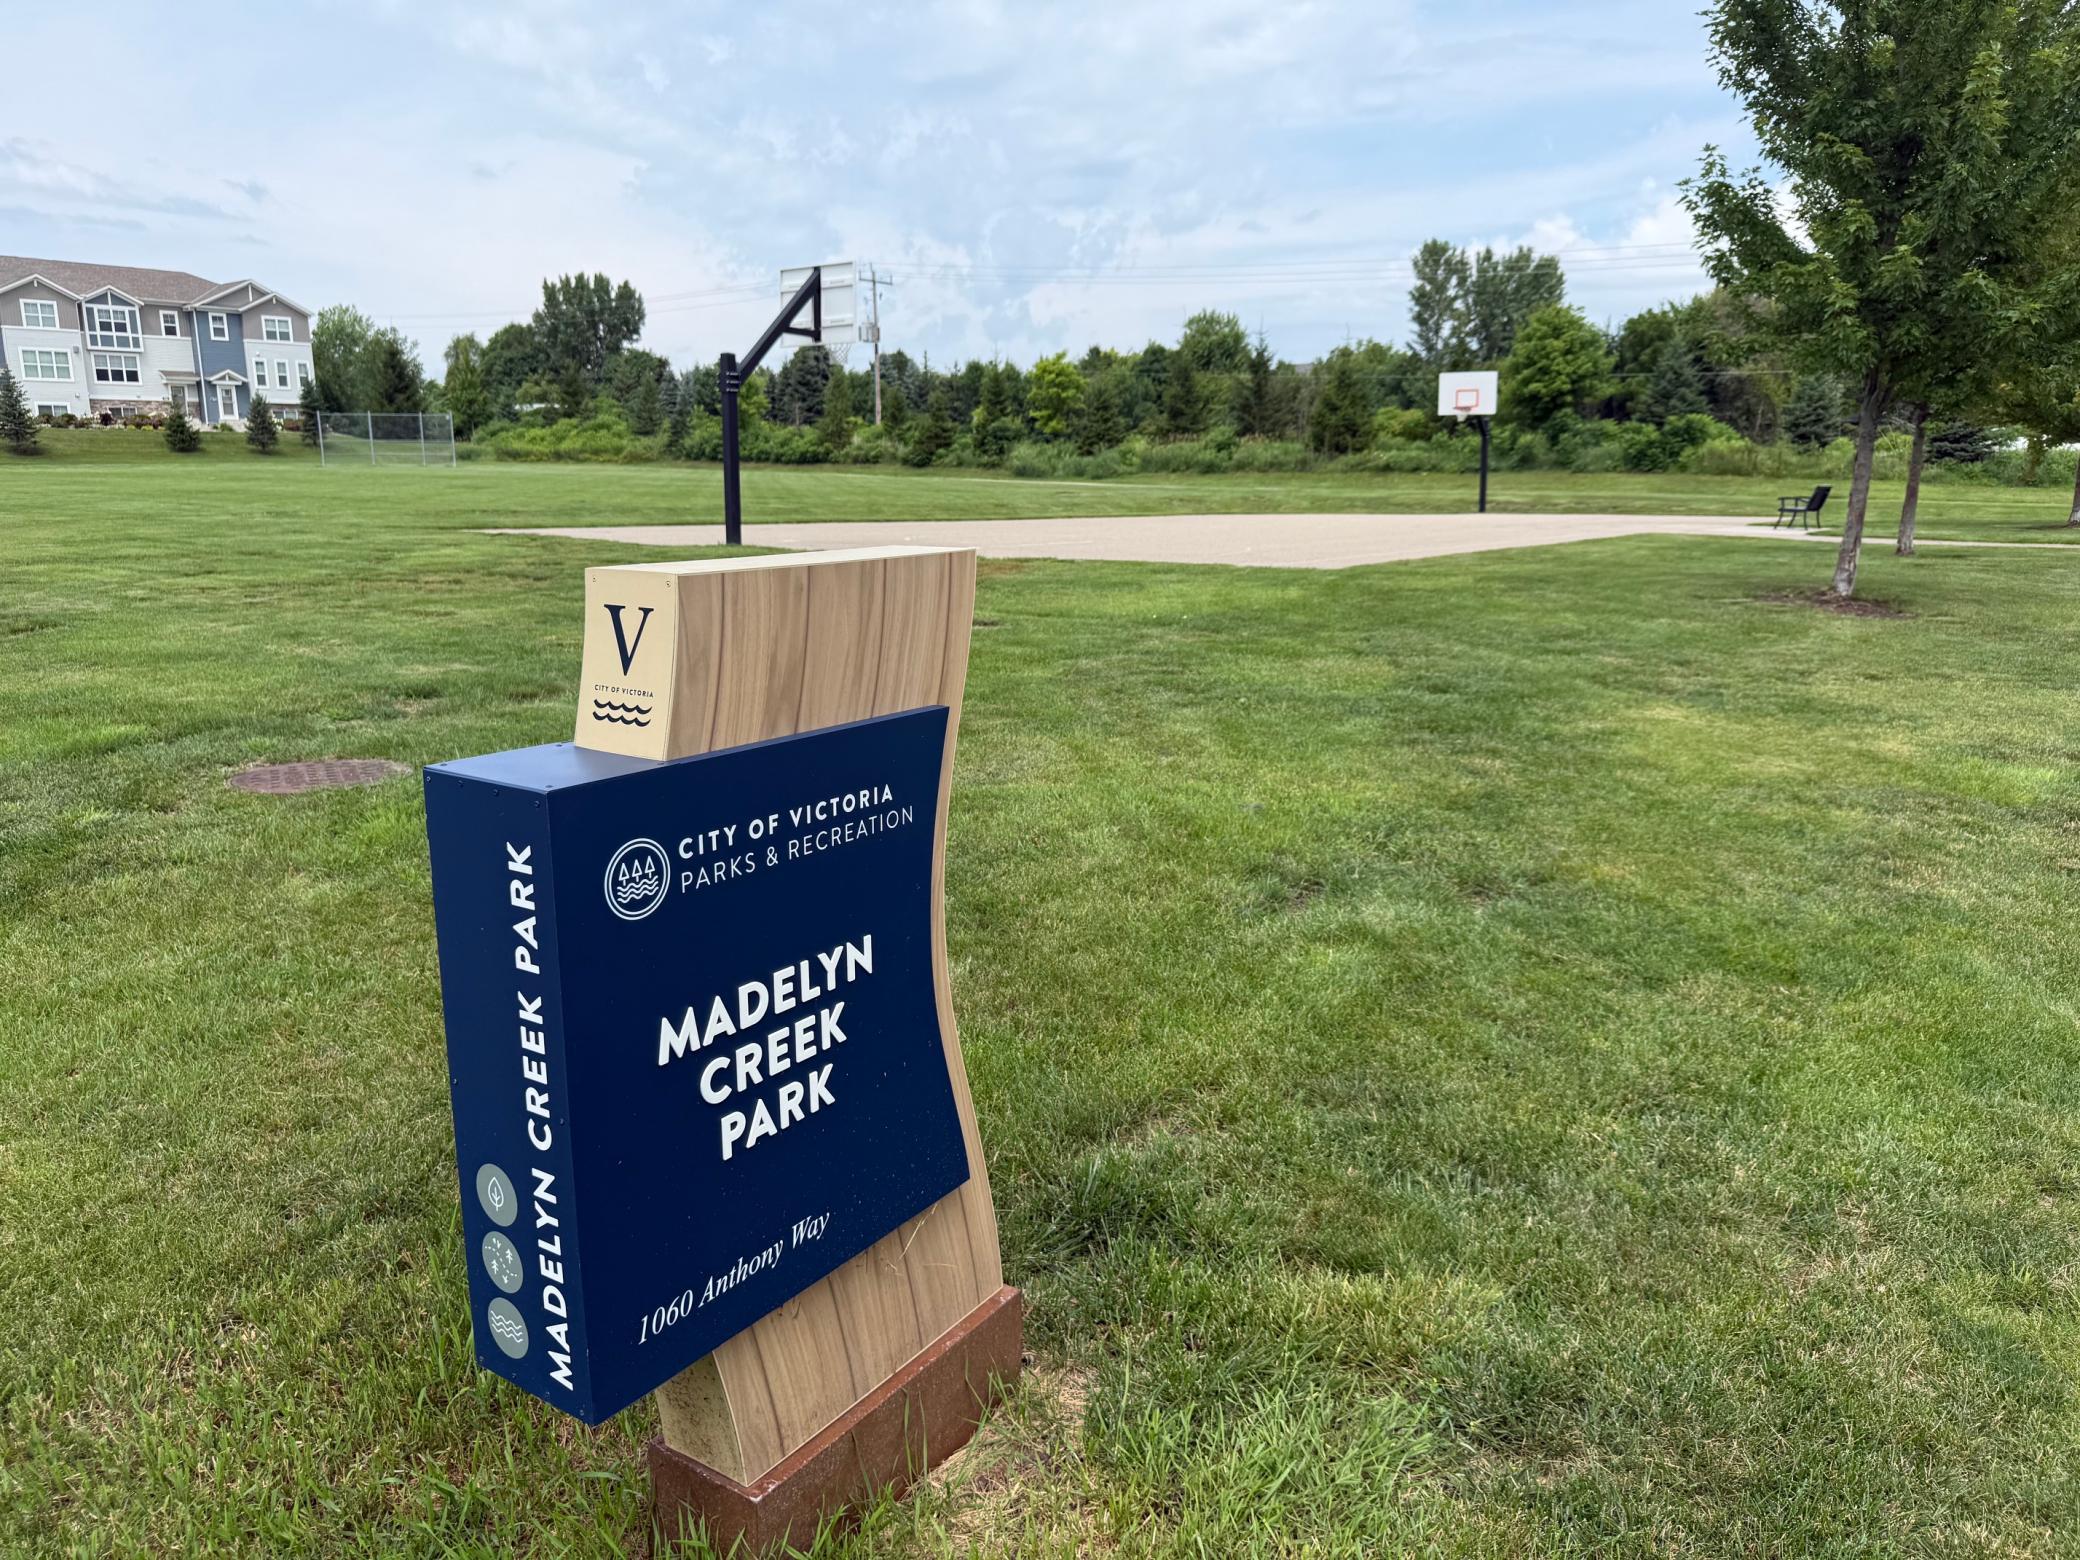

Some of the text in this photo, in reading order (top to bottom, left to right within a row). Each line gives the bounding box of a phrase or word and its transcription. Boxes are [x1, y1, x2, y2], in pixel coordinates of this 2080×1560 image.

[603, 604, 655, 677] V
[594, 684, 609, 692] CITY
[621, 687, 654, 698] VICTORIA
[678, 783, 893, 860] CITY OF VICTORIA
[681, 805, 914, 894] PARKS & RECREATION
[658, 934, 873, 1066] MADELYN
[700, 1001, 847, 1105] CREEK
[506, 841, 574, 1391] MADELYN CREEK PARK
[721, 1063, 836, 1161] PARK
[638, 1211, 830, 1345] 1060 Anthony Way
